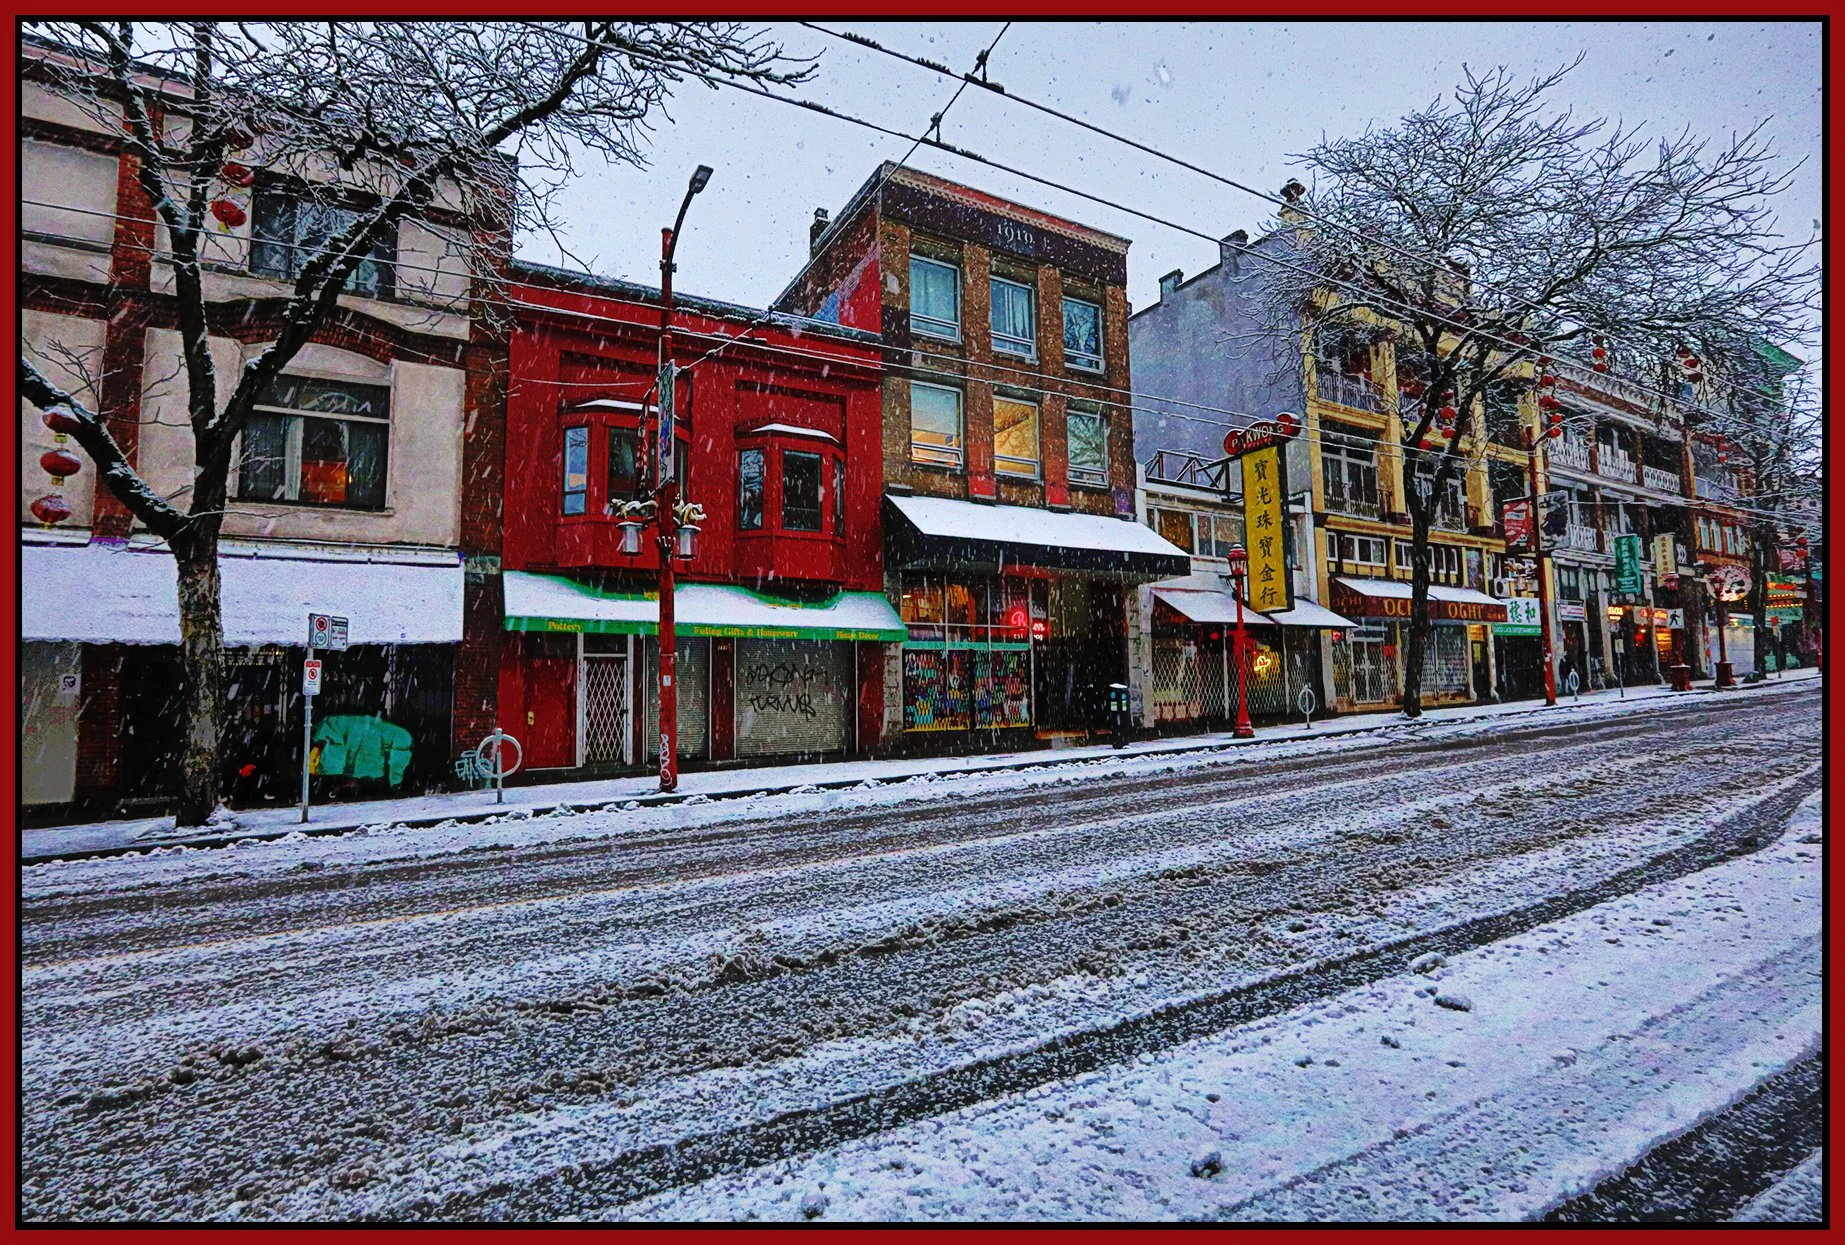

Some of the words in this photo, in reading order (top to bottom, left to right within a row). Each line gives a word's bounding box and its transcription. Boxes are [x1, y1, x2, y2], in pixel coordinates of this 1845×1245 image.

[1254, 459, 1278, 606] 寶光珠寶金行
[548, 621, 582, 632] Pottery
[724, 627, 744, 636] Gifts
[747, 628, 753, 636] &
[859, 631, 879, 640] Decor
